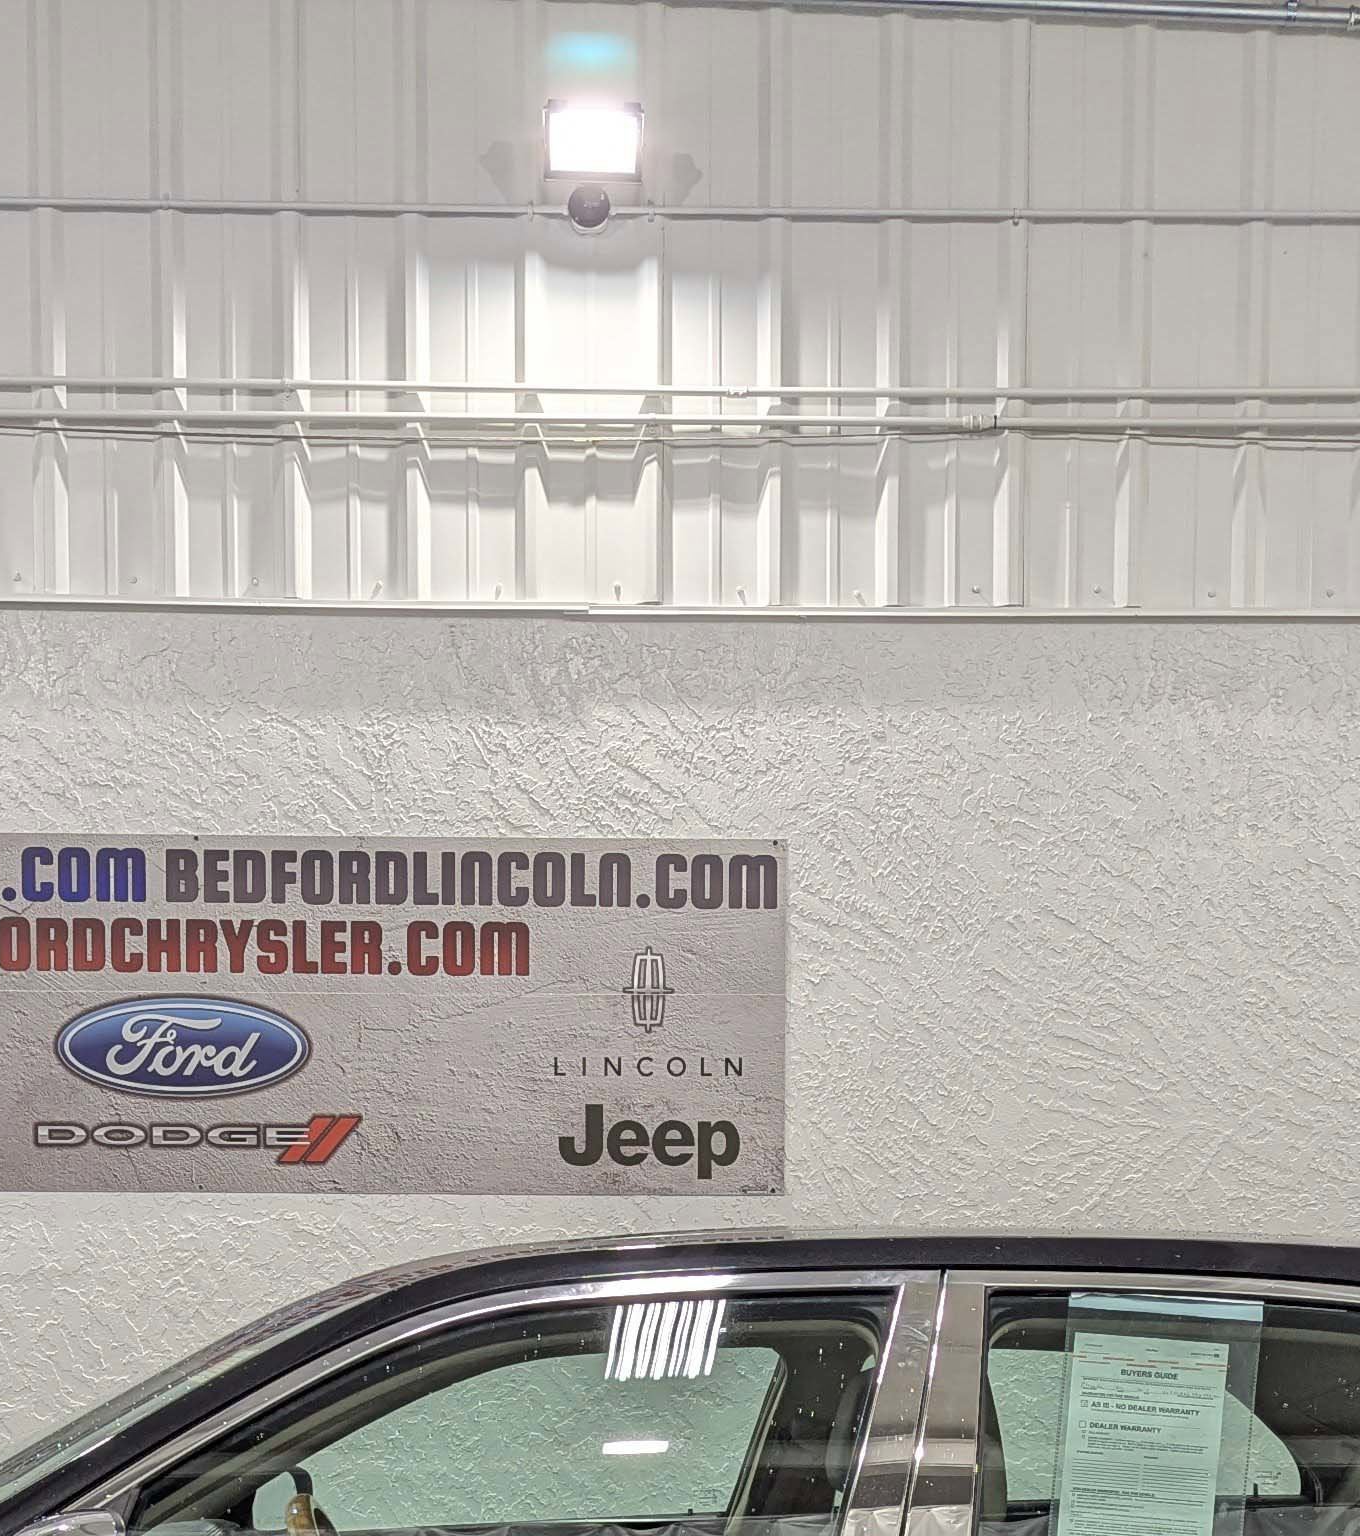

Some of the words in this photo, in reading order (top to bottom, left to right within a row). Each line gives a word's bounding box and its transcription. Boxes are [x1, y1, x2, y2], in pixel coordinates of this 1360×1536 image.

[165, 848, 779, 909] BEDFORDLINCOLN.COM
[105, 1013, 262, 1077] Ford
[553, 1056, 743, 1077] LINCOLN
[35, 1122, 312, 1148] DODGE
[558, 1104, 740, 1179] Jeep
[1120, 1368, 1153, 1378] BUYERS
[1154, 1371, 1178, 1380] GUIDE
